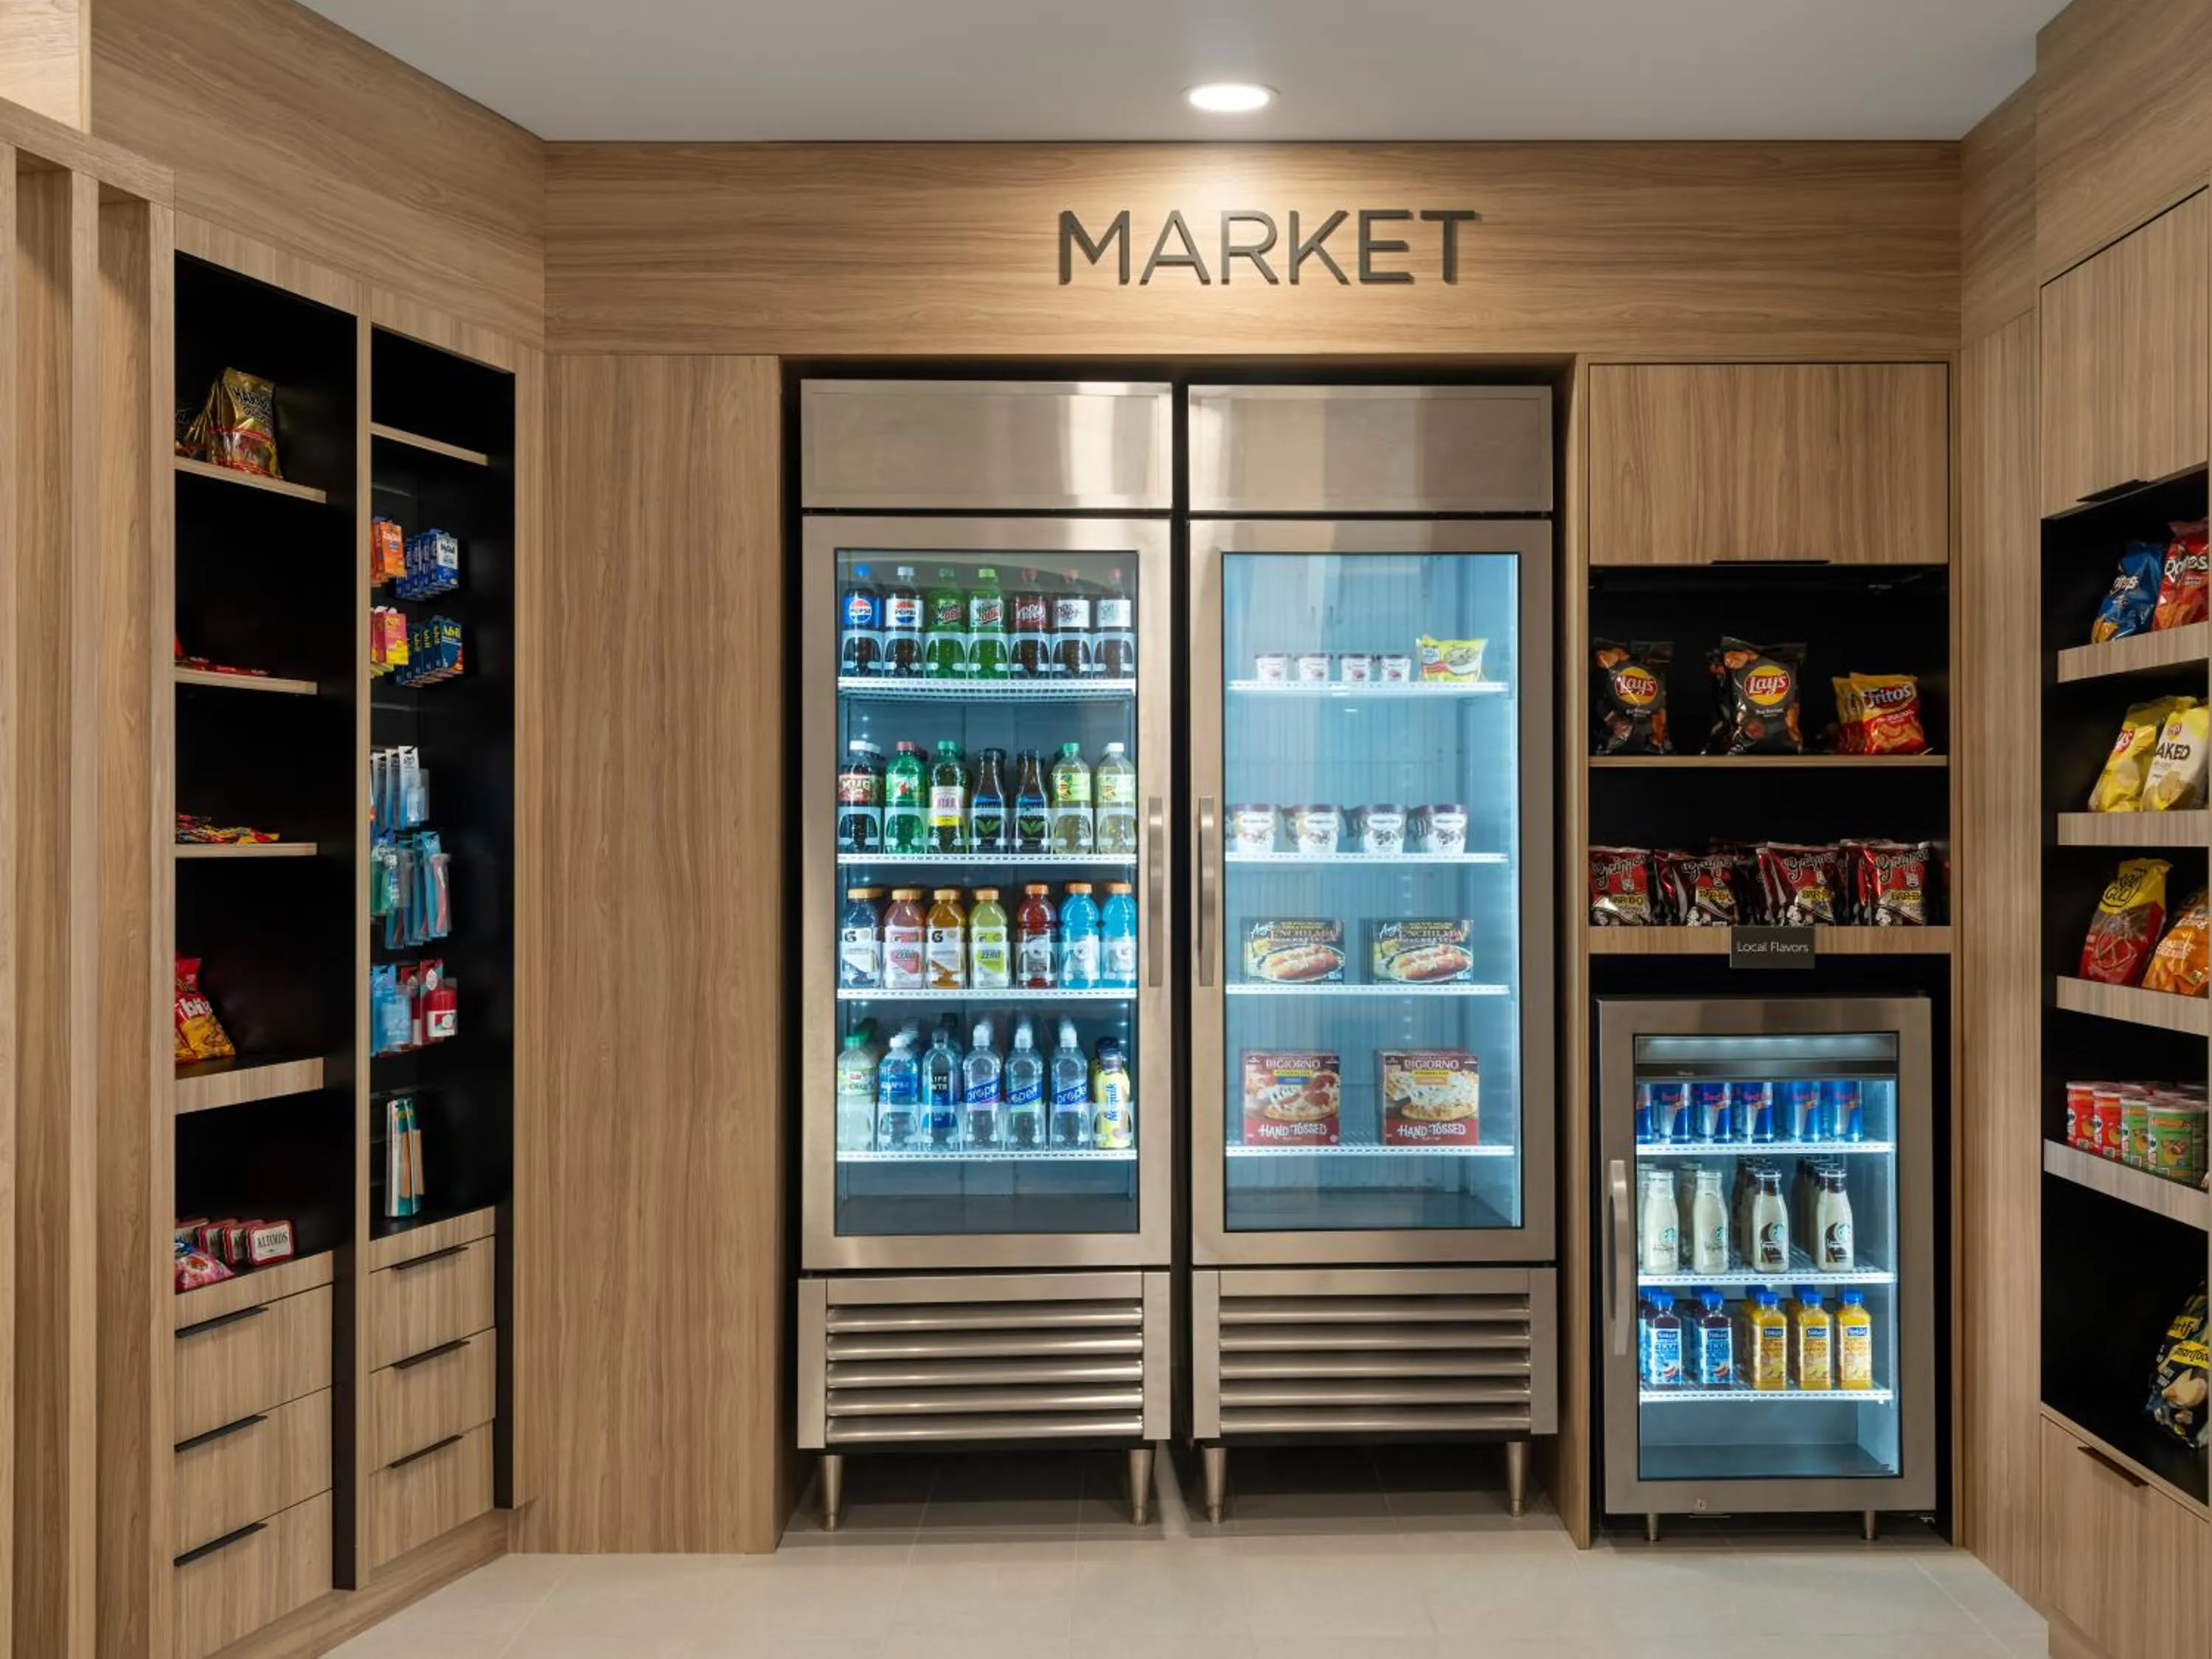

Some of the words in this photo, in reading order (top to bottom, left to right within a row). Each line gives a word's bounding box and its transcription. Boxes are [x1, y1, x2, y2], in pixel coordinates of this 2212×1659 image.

[1058, 209, 1480, 285] MARKET
[1863, 685, 1912, 709] Fritos
[2155, 742, 2191, 760] AKED
[1736, 941, 1767, 952] Local
[1770, 941, 1809, 953] Flavors
[967, 1083, 998, 1102] prope
[1057, 1086, 1086, 1104] prope
